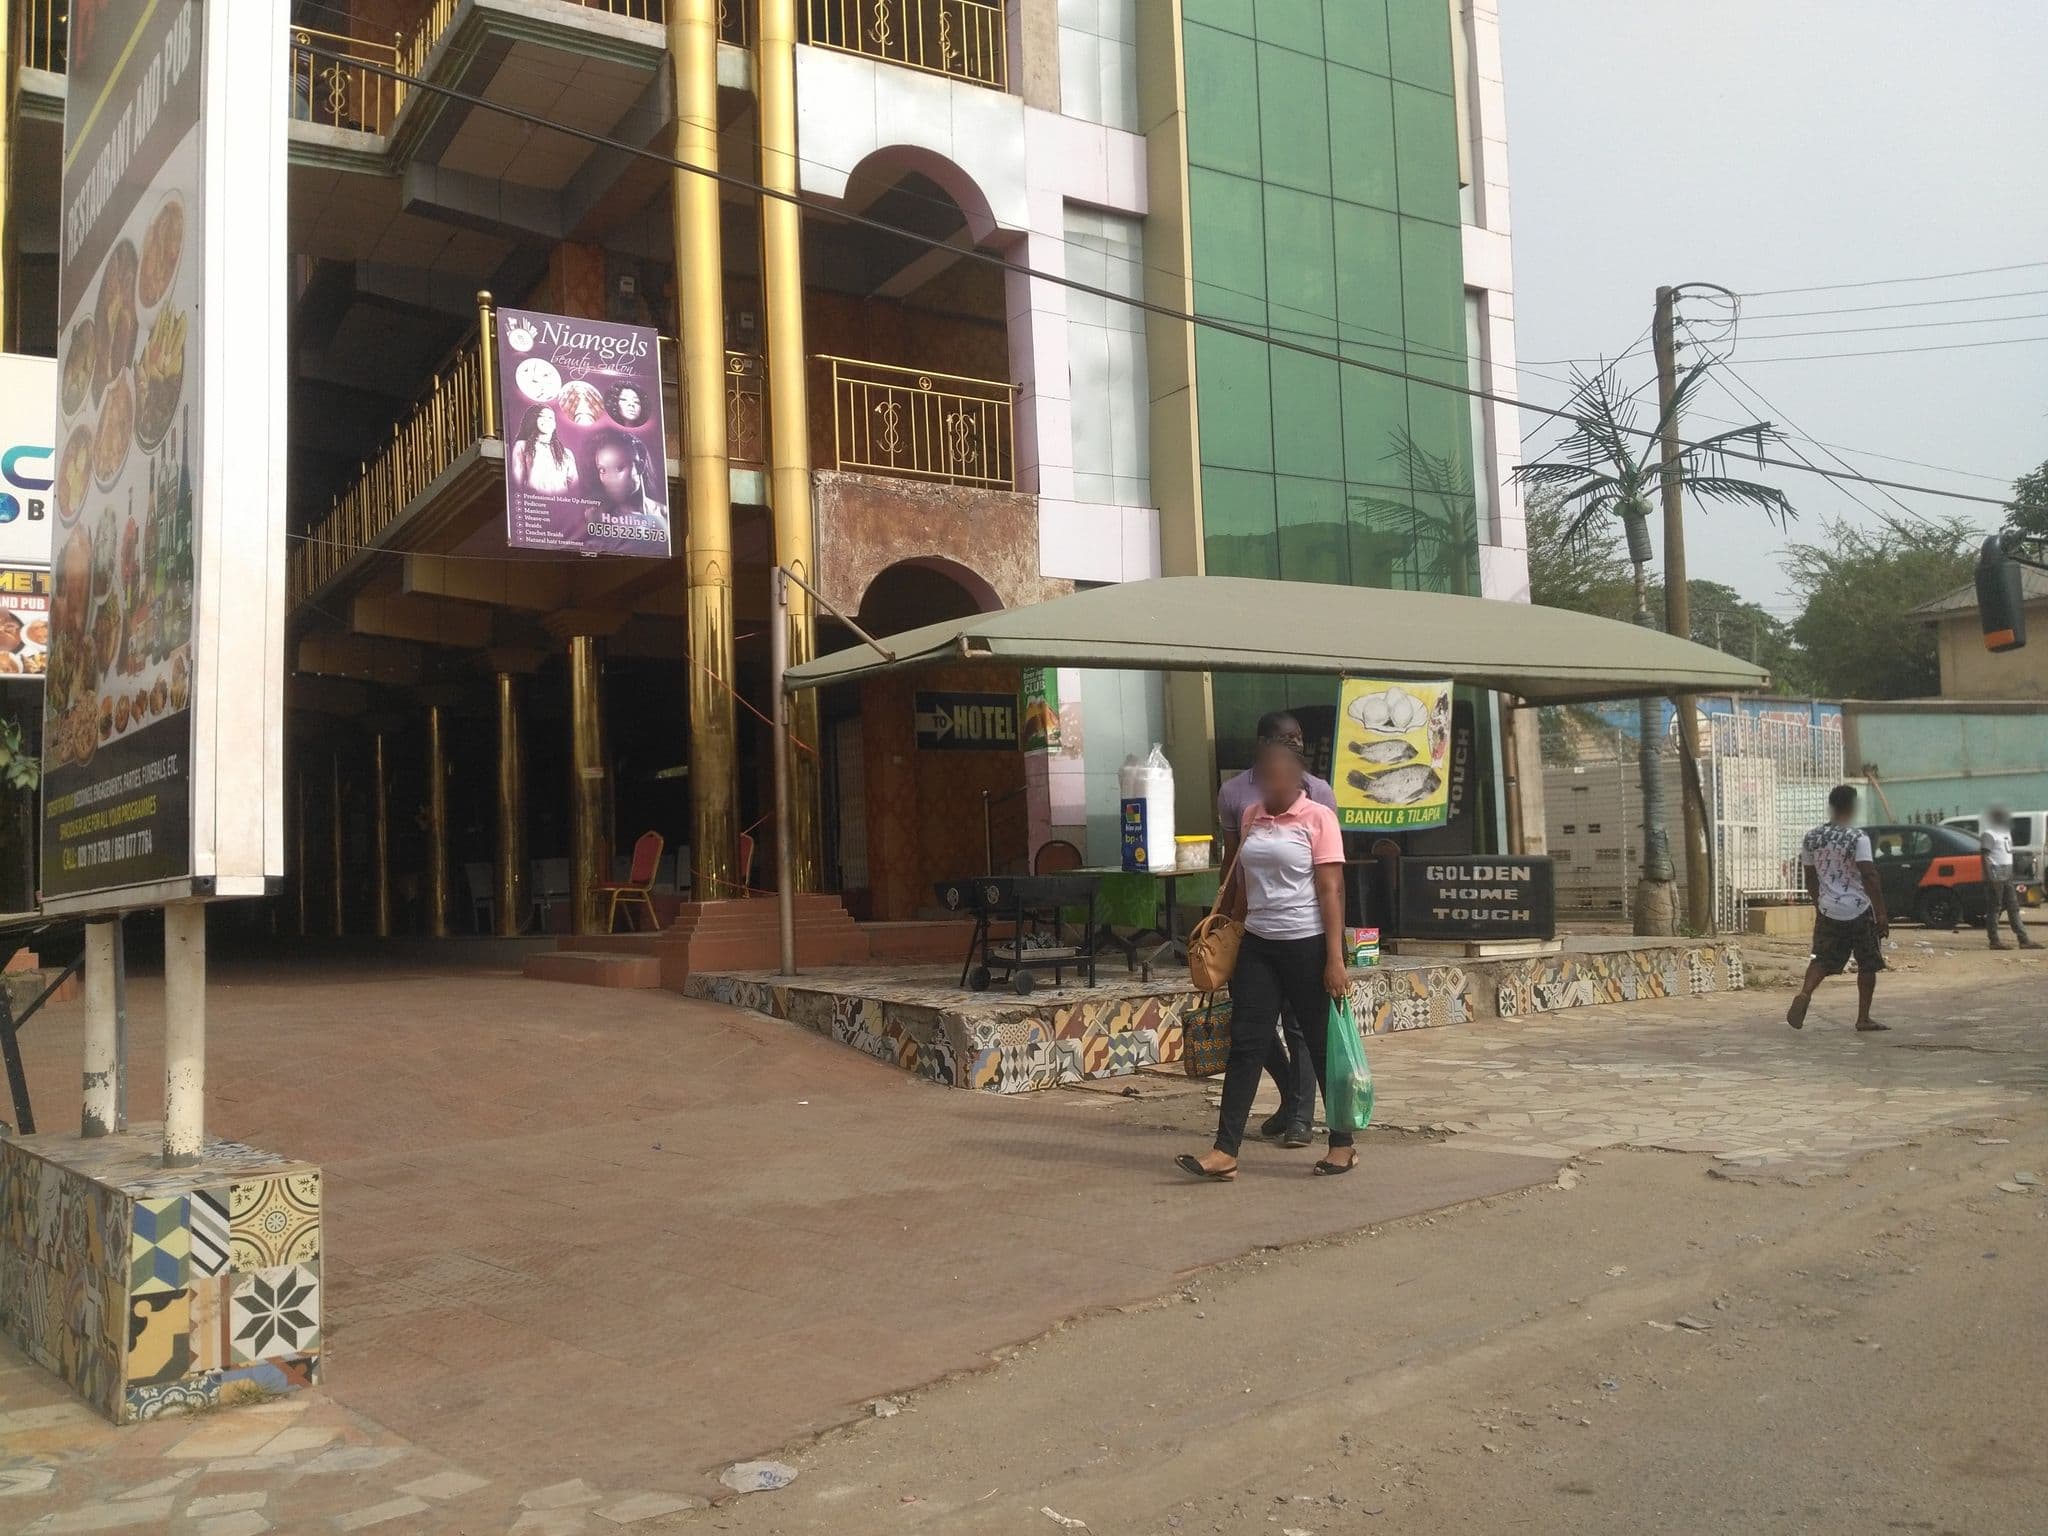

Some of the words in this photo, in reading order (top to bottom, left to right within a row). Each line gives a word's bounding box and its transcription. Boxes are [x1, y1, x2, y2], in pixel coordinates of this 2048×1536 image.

[67, 99, 133, 267] RESTAURANT
[133, 52, 161, 155] AND
[163, 0, 192, 104] PUB
[539, 320, 648, 359] Niangels
[523, 493, 556, 502] Professional
[523, 500, 547, 508] Pedicure
[601, 513, 648, 527] Hotline
[587, 523, 667, 542] 0555225573
[0, 596, 18, 608] ND
[20, 597, 45, 610] PUB
[1024, 681, 1046, 694] CLUB
[953, 704, 1016, 740] HOTEL
[1346, 809, 1393, 824] BANKU
[1396, 811, 1404, 823] &
[1407, 807, 1441, 822] TILAPIA
[1426, 865, 1531, 881] GOLDEN
[1439, 888, 1519, 900] HOME
[1432, 908, 1530, 921] TOUCH
